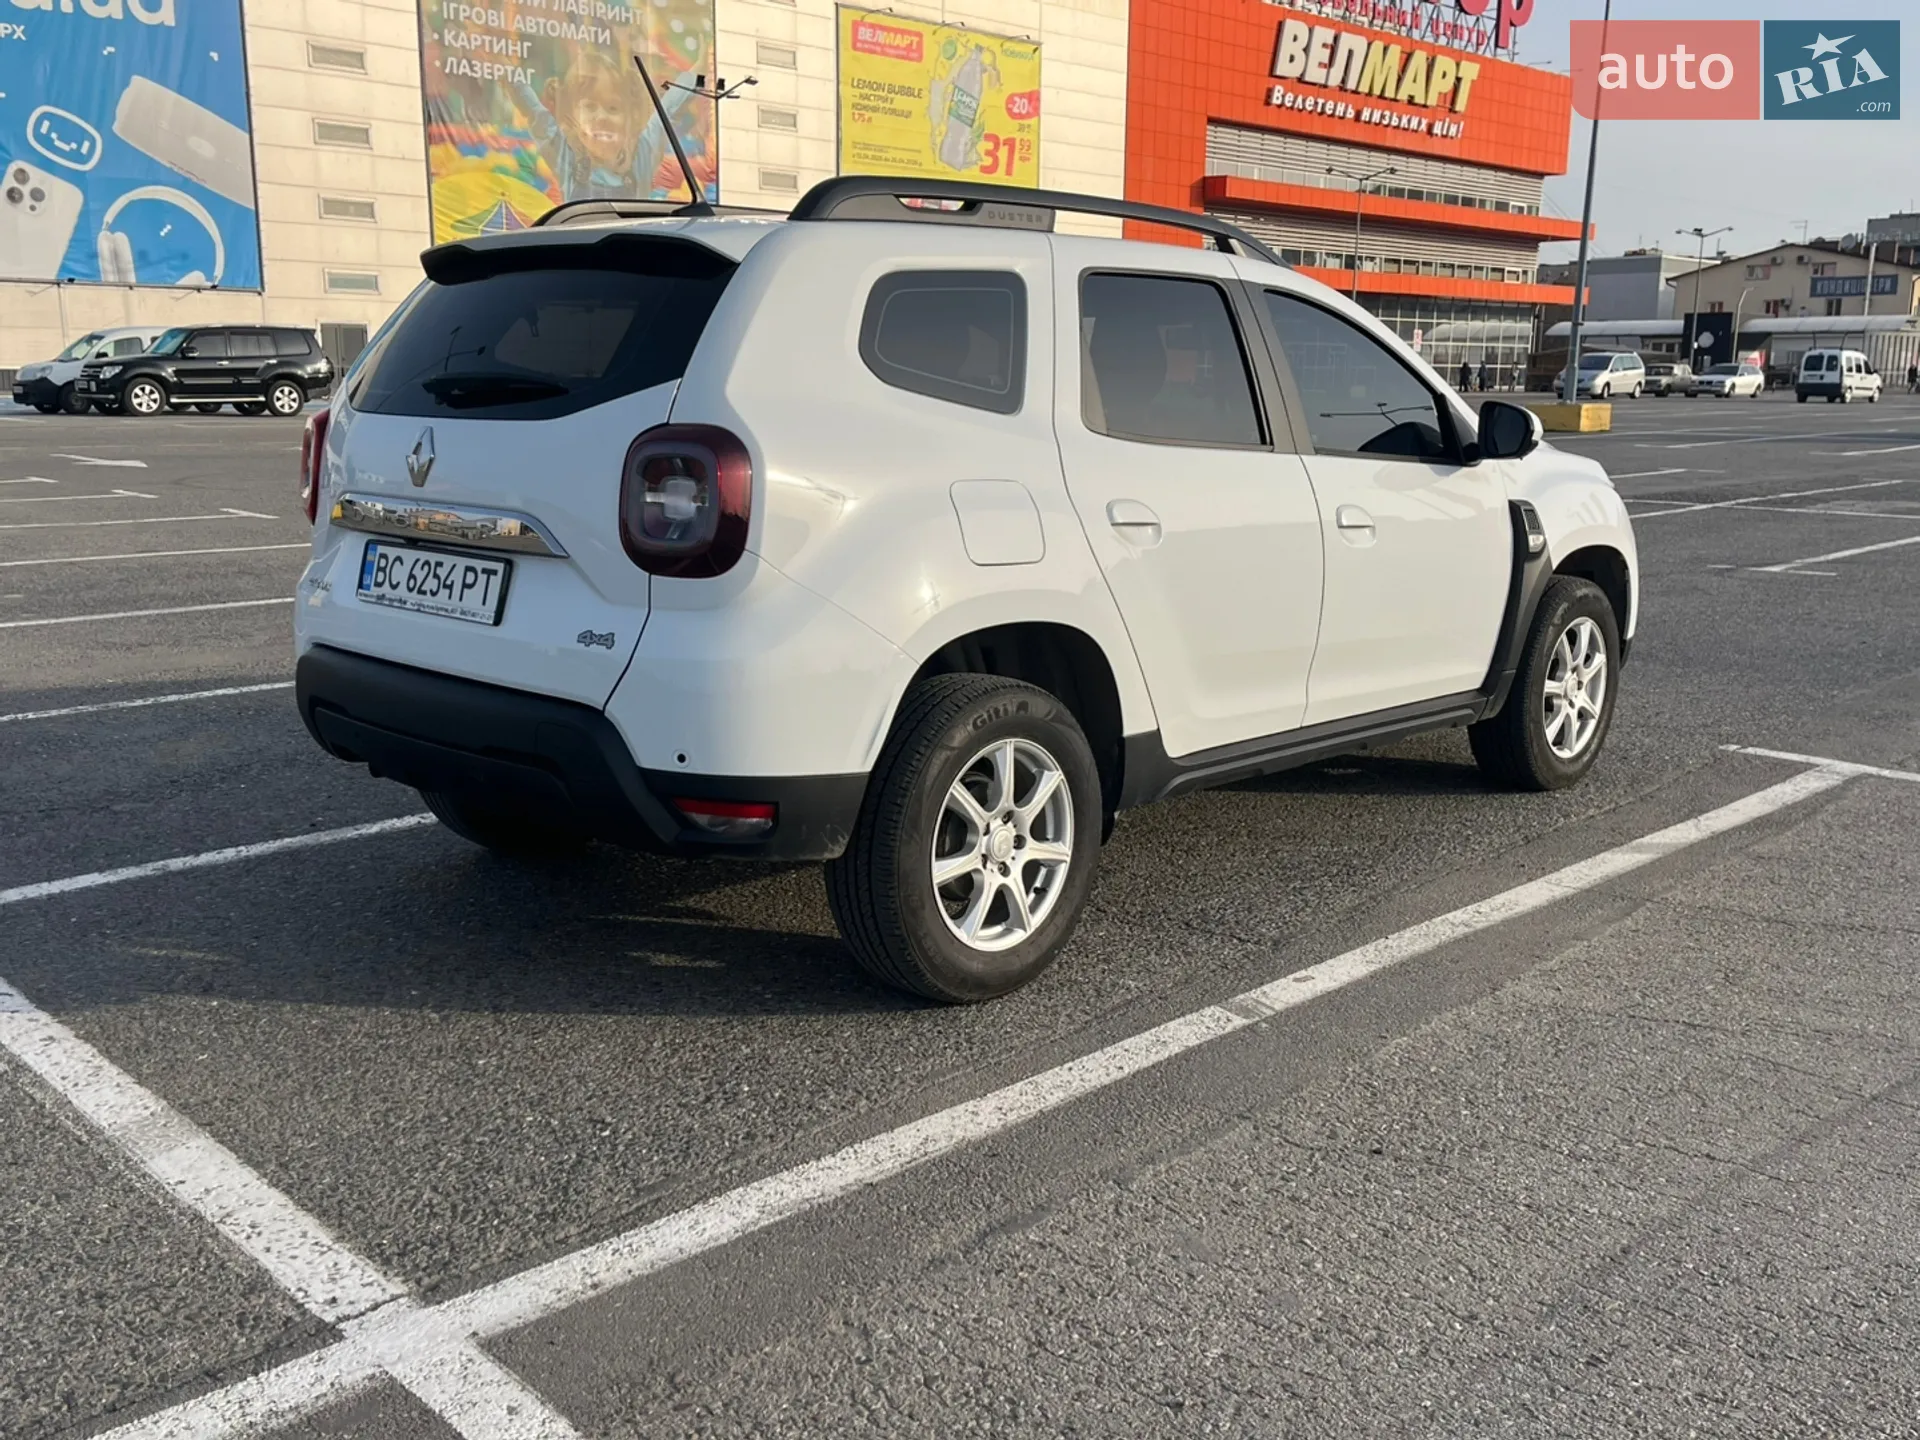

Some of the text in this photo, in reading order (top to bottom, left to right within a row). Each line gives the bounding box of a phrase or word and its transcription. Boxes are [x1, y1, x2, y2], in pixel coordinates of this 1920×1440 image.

[442, 2, 612, 46] ІГРОВІ АВТОМАТИ
[444, 28, 533, 59] КАРТИНГ
[444, 56, 536, 86] ЛАЗЕРТАГ
[1272, 18, 1480, 113] ВЕЛМАРТ
[850, 77, 924, 99] LEMON BUBBLE
[1271, 84, 1465, 139] Велетень низьких цін!
[979, 133, 1016, 176] 31
[988, 210, 1043, 224] DUSTER
[373, 553, 404, 590] BC
[406, 558, 457, 600] 6254
[459, 565, 498, 606] PT
